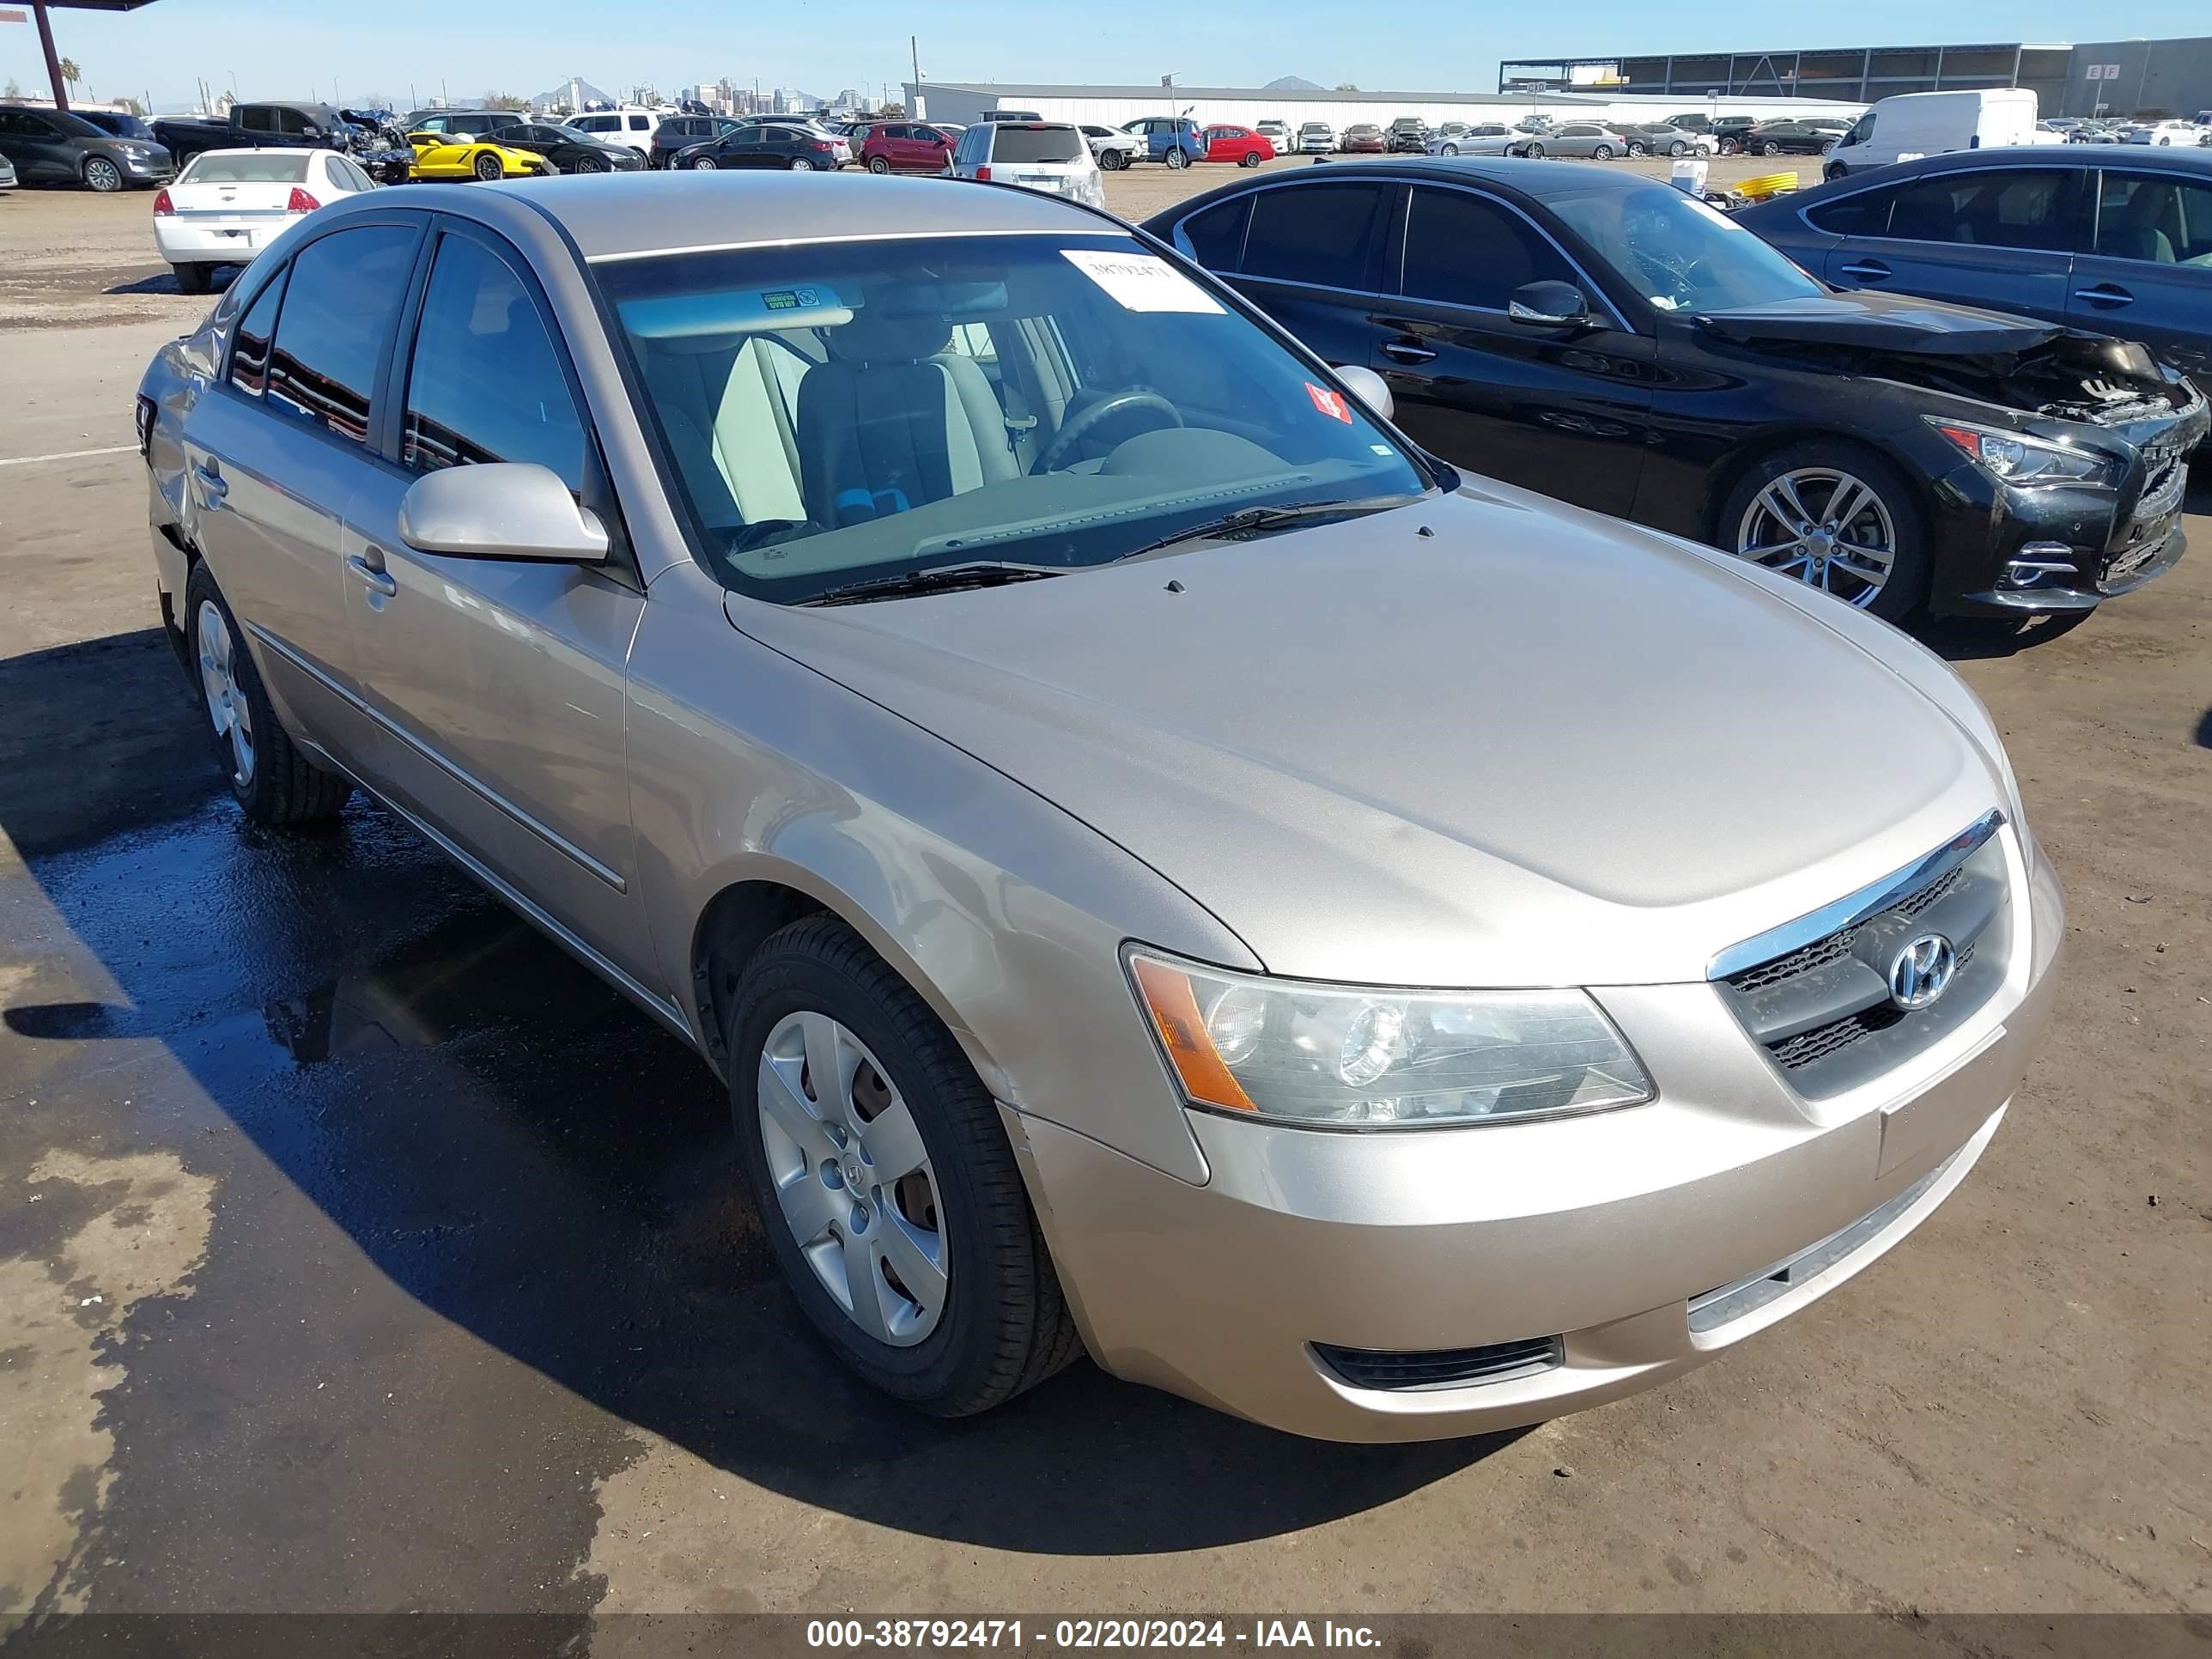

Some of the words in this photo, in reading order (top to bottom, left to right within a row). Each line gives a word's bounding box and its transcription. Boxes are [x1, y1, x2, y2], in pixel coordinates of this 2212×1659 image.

[2091, 68, 2098, 76] E
[2108, 68, 2116, 76] F
[1088, 264, 1171, 278] 38792471
